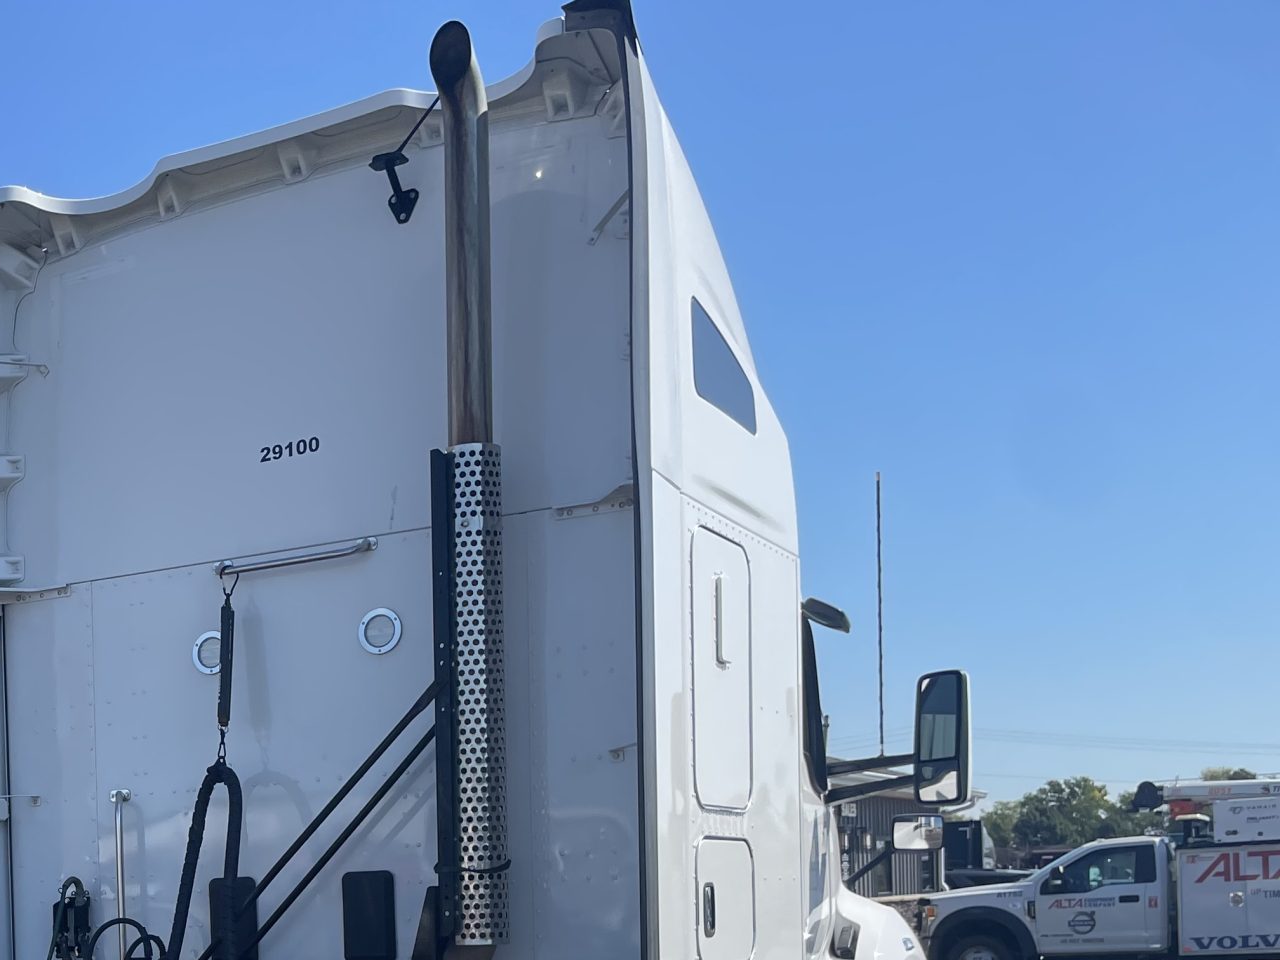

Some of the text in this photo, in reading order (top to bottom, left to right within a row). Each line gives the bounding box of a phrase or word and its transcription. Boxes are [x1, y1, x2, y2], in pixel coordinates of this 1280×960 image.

[260, 436, 320, 463] 29100
[1048, 898, 1083, 910] ALTA
[1188, 933, 1280, 950] VOLV
